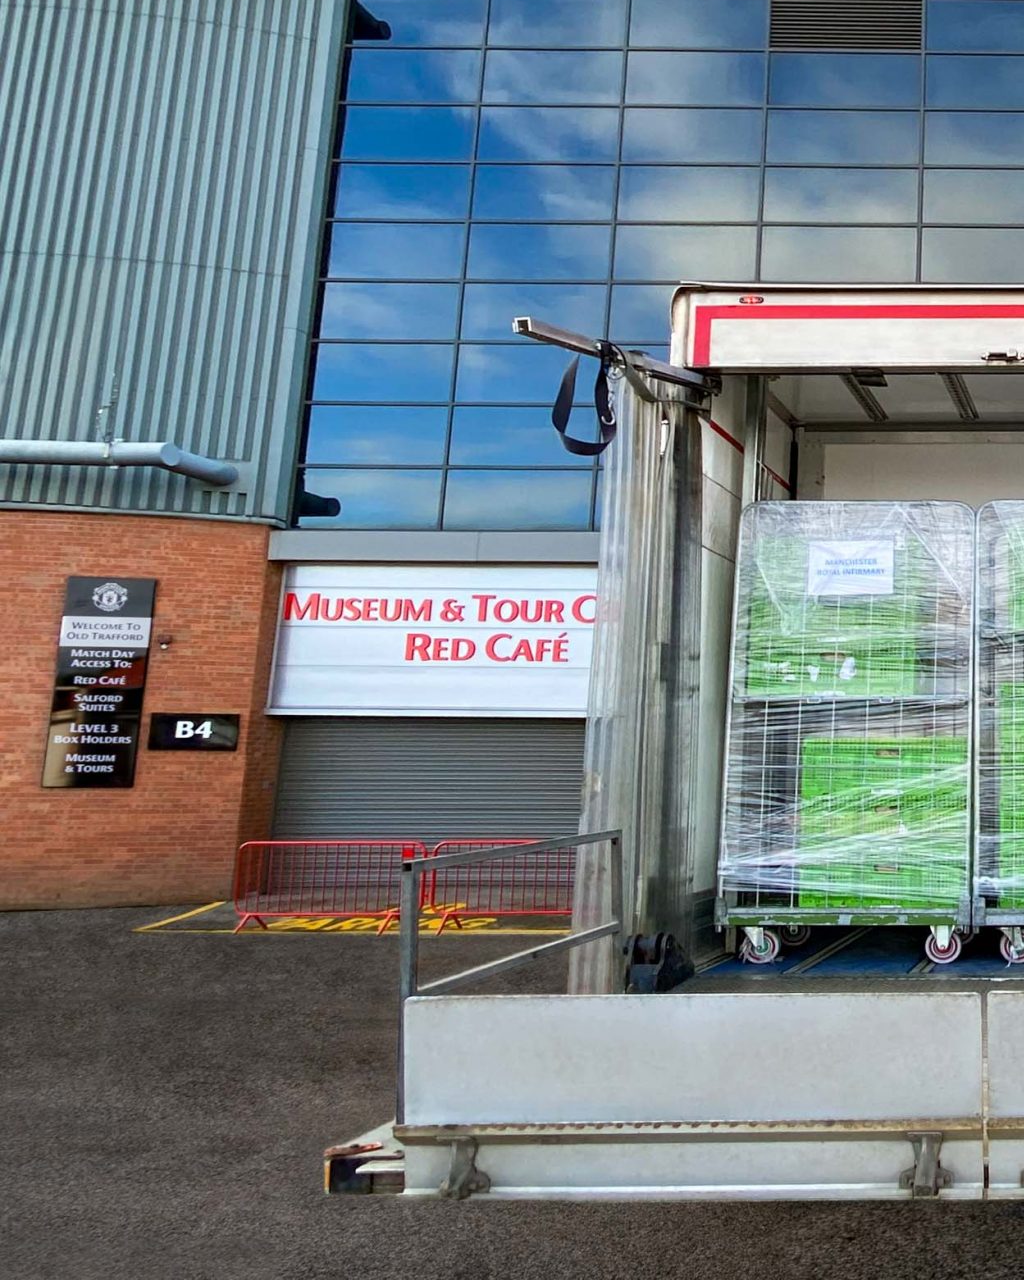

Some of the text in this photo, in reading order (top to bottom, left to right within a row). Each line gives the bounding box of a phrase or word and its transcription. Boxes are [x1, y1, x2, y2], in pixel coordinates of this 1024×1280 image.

[283, 592, 432, 621] MUSEUM
[440, 598, 465, 622] &
[472, 594, 565, 623] TOUR
[72, 621, 125, 631] WELCOME
[66, 631, 144, 641] OLD TRAFFORD
[404, 632, 570, 662] RED CAFÉ
[71, 649, 136, 658] MATCH DAY
[71, 659, 111, 668] ACCESS
[73, 675, 126, 685] RED CAFÉ
[73, 693, 123, 702] SALFORD
[77, 703, 116, 712] SUITES
[69, 723, 119, 733] LEVEL 3
[174, 720, 213, 739] B4
[54, 735, 132, 744] BOX HOLDERS
[65, 753, 116, 762] MUSEUM
[77, 764, 114, 773] TOURS
